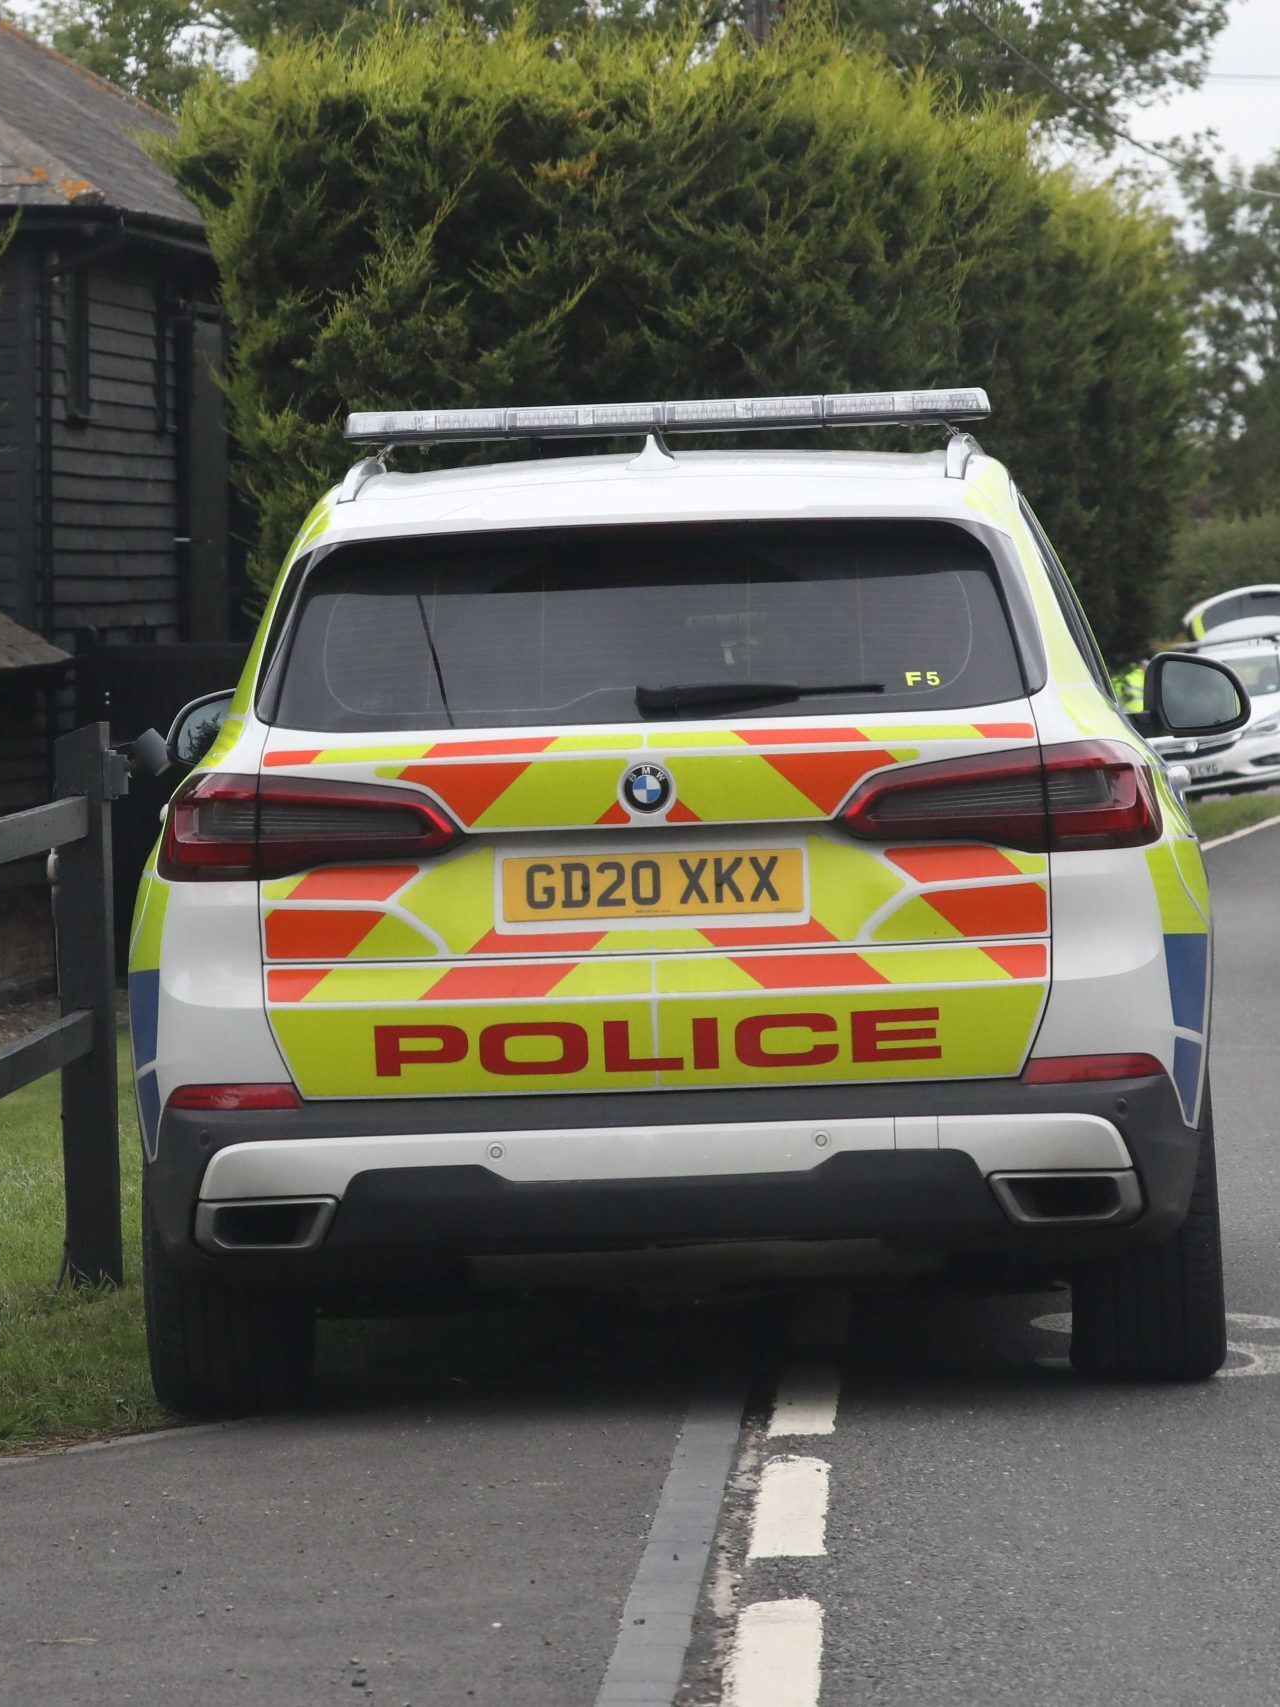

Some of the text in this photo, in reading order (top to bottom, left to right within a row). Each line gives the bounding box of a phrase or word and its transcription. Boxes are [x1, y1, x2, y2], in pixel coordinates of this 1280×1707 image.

[627, 766, 666, 782] BMW
[525, 855, 781, 910] GD20 XKX
[373, 1006, 943, 1078] POLICE
